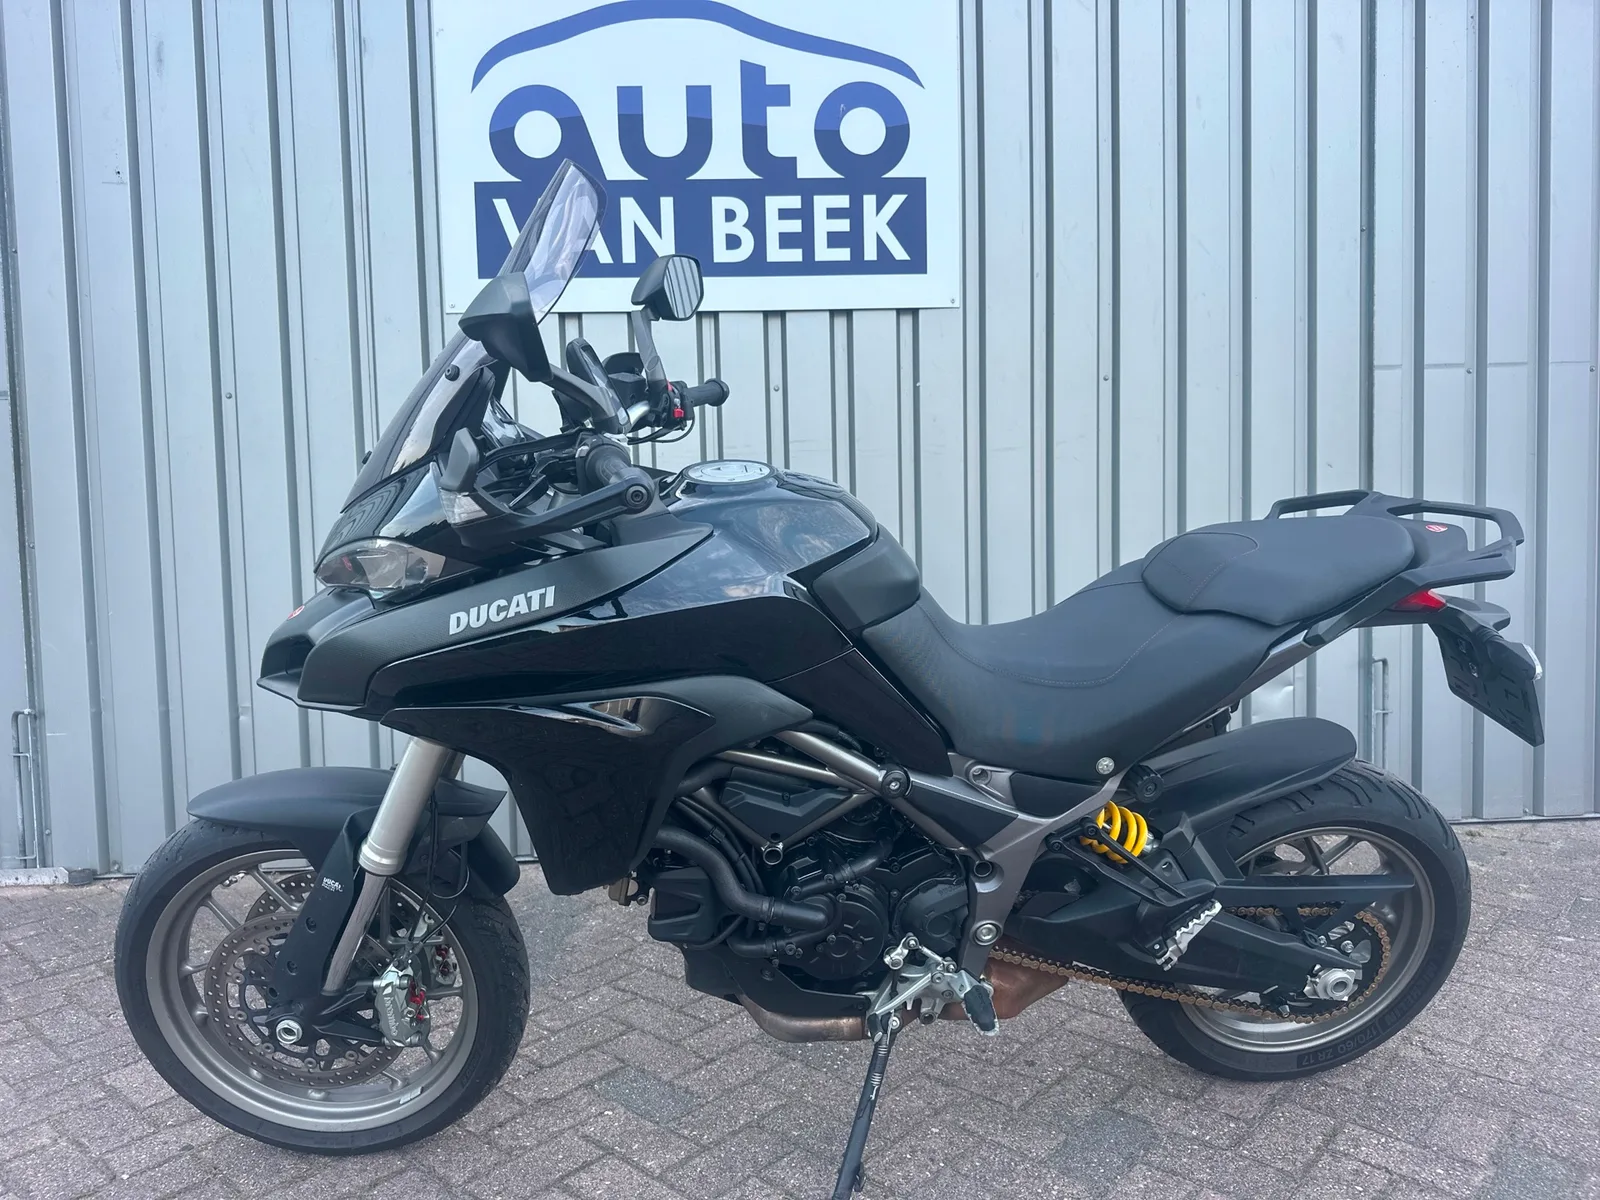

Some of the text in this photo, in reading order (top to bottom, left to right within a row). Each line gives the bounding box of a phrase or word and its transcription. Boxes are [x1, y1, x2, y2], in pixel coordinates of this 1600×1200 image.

[489, 60, 910, 181] auto
[711, 193, 911, 263] BEEK
[449, 585, 555, 635] DUCATI
[1317, 1047, 1335, 1062] ZR
[1337, 1026, 1378, 1052] 170/60
[1302, 1053, 1315, 1066] 17
